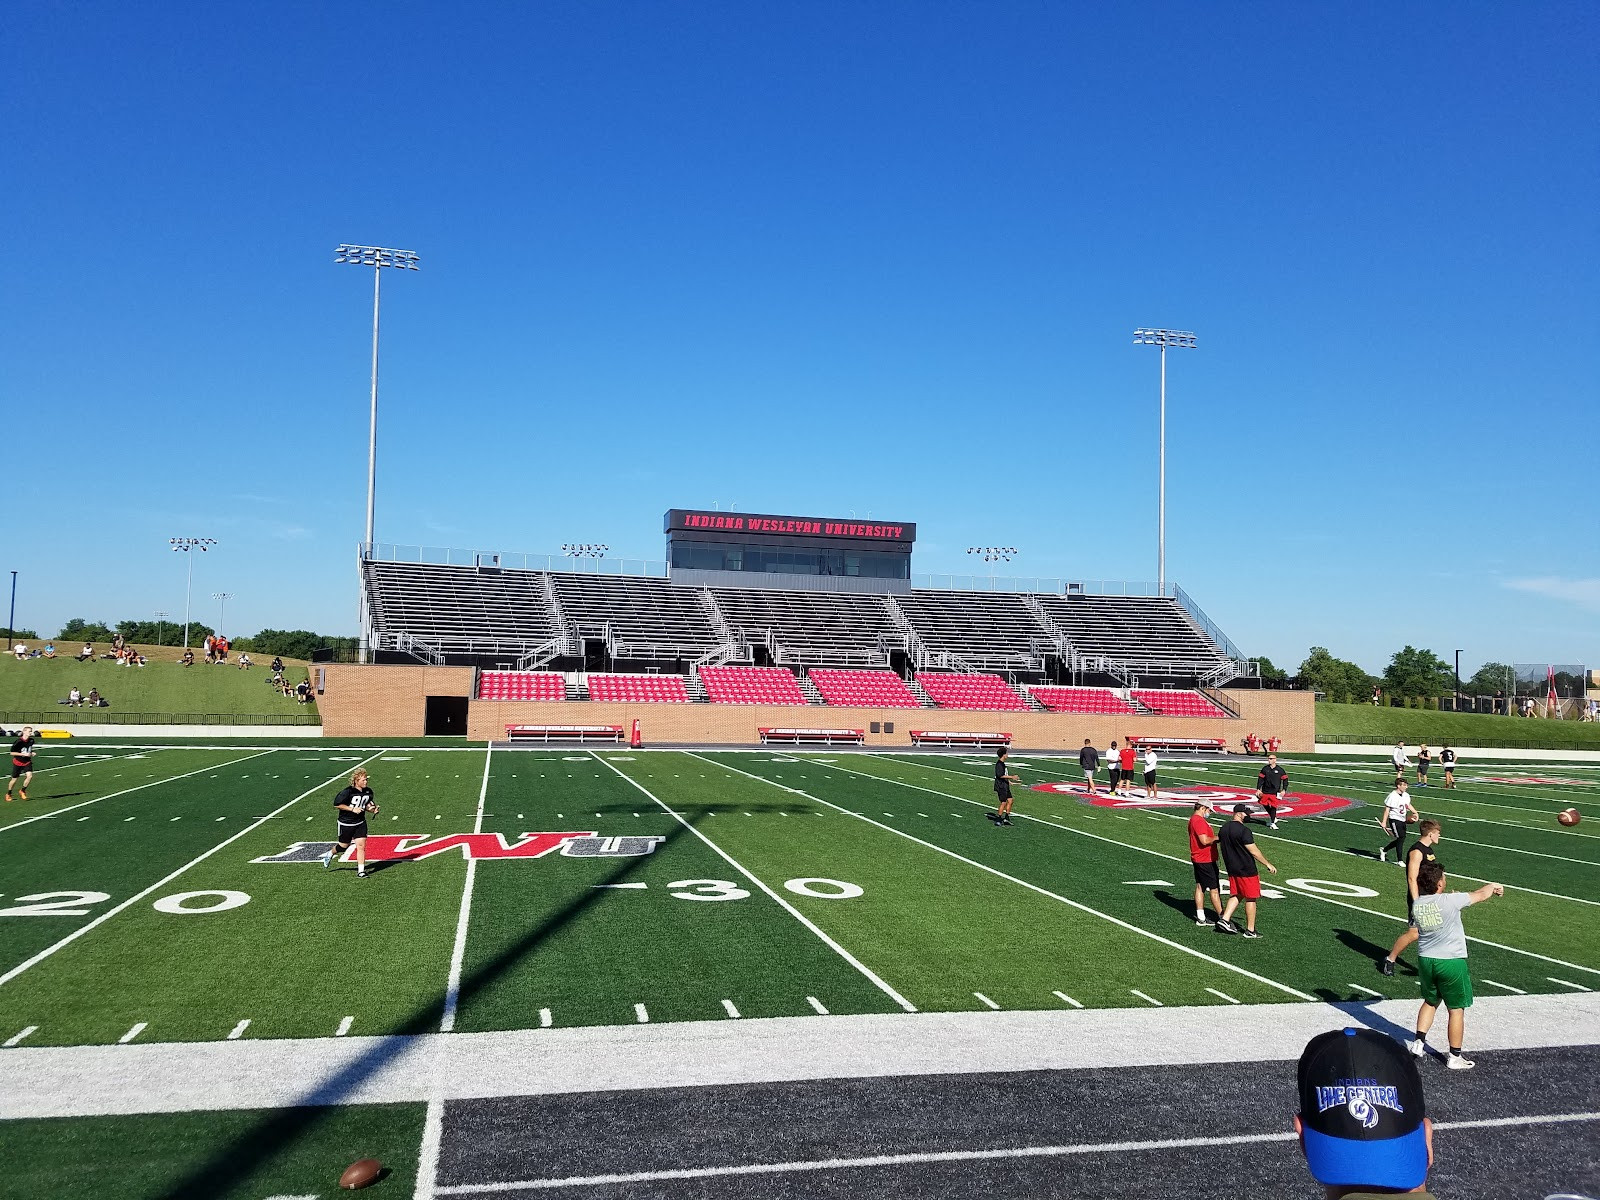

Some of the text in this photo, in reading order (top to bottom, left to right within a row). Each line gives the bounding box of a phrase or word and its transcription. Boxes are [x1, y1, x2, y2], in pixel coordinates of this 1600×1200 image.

[684, 514, 903, 538] INDIANA WESLEYAN UNIVERSITY
[1412, 902, 1443, 916] PECIAL
[1415, 913, 1444, 928] EAMS
[1315, 1086, 1404, 1113] LAKE CENTRAL
